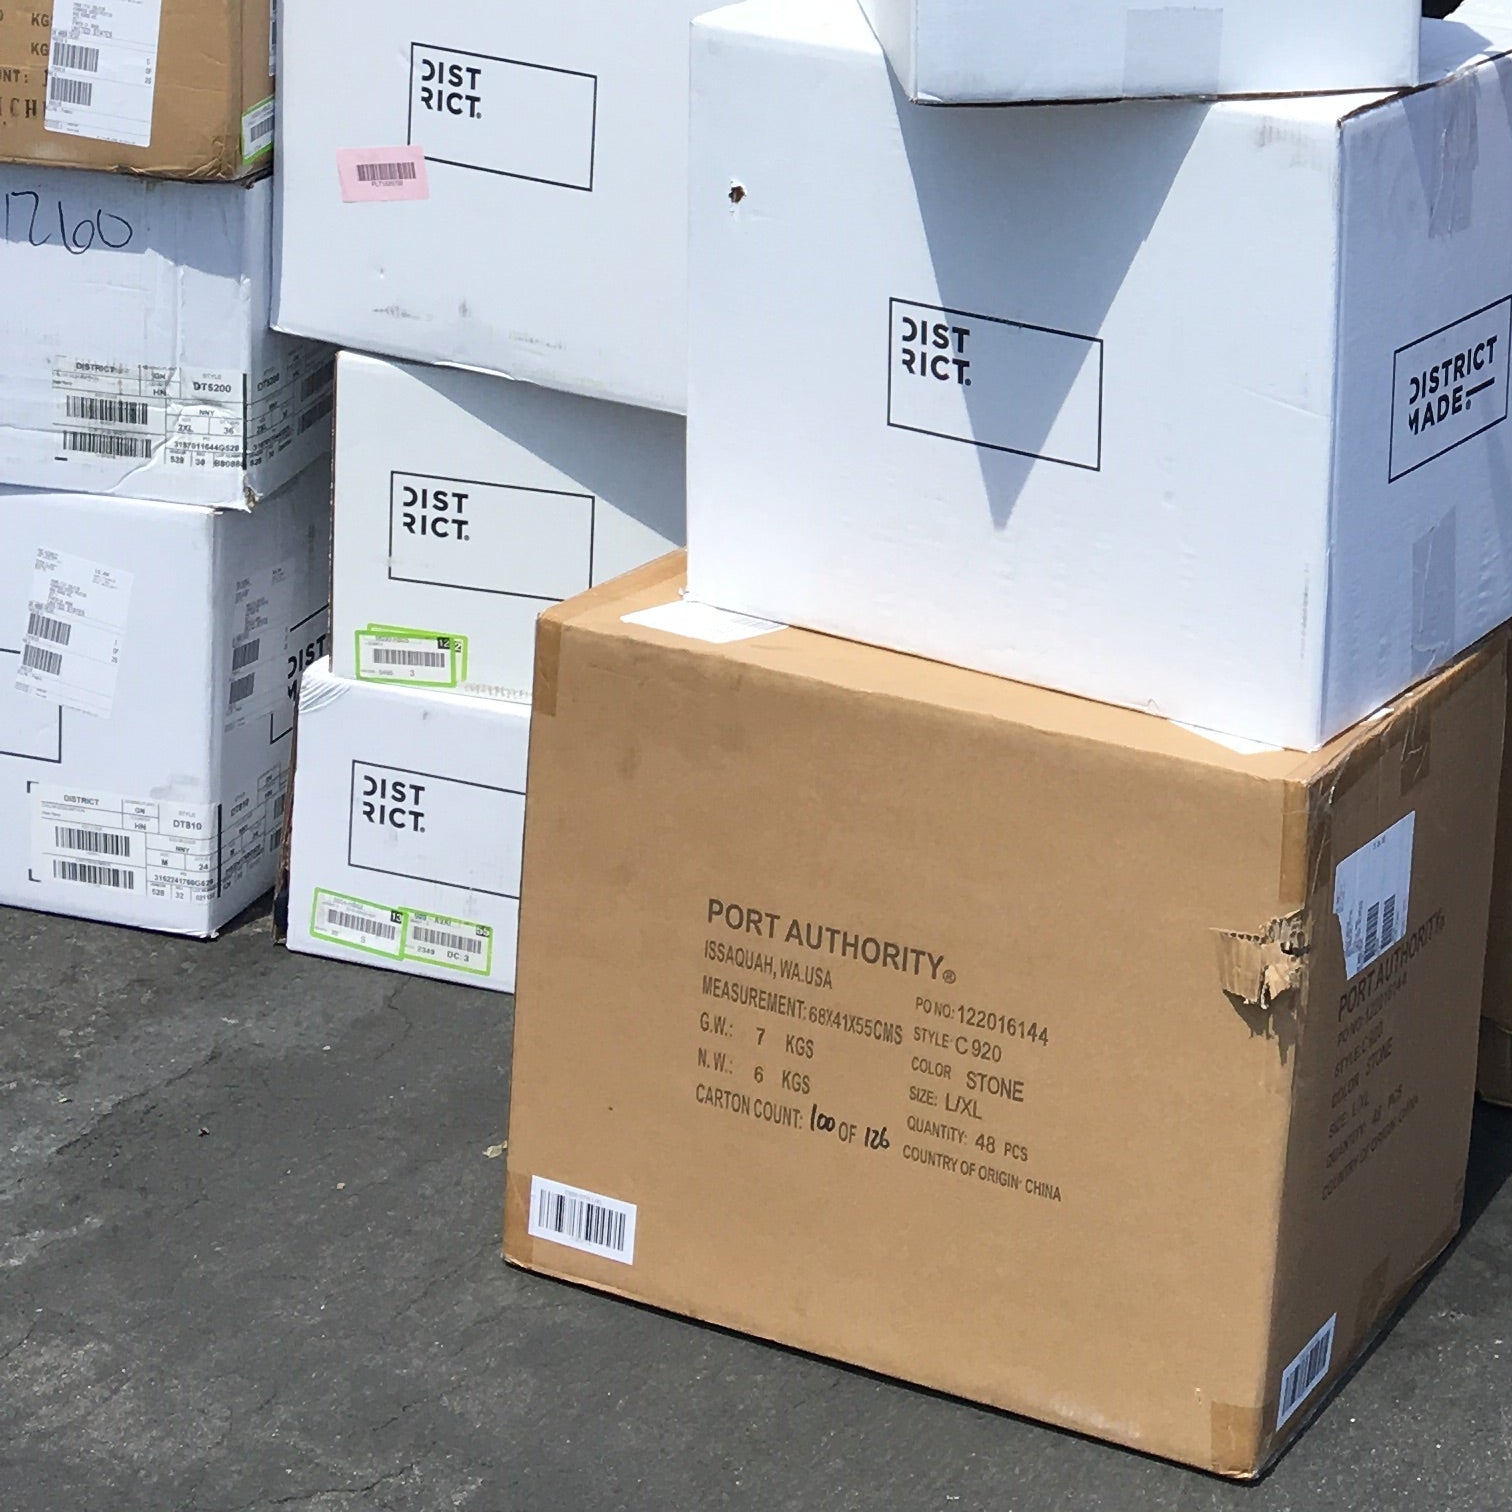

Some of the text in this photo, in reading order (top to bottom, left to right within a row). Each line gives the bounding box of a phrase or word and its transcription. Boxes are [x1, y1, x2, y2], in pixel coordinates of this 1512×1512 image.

[421, 58, 482, 90] DIST
[902, 316, 970, 353] DIST
[75, 361, 116, 374] DISTRICT
[1409, 335, 1498, 405] DISTRICT
[192, 381, 232, 393] DT5200
[403, 485, 469, 514] DIST
[63, 794, 100, 806] DISTRICT
[363, 774, 426, 806] DIST
[172, 819, 203, 831] DT810
[708, 897, 782, 939] PORT
[446, 950, 460, 961] DC
[703, 939, 777, 980] ISSAQUAH,
[1338, 969, 1376, 1023] PORT
[915, 996, 1050, 1046] PO NO: 122016144
[755, 1027, 766, 1046] 7
[785, 1033, 815, 1060] KGS
[954, 1036, 969, 1055] C
[971, 1039, 1003, 1063] 920
[754, 1065, 764, 1084] 6
[781, 1069, 811, 1095] KGS
[911, 1055, 1025, 1103] COLOR STONE
[695, 1083, 750, 1116] CARTON
[753, 1098, 804, 1130] COUNT:
[838, 1121, 858, 1144] OF
[945, 1092, 983, 1120] L/XL
[906, 1115, 1029, 1162] QUANTITY: 48 PCS
[902, 1144, 958, 1173] COUNTRY
[959, 1160, 976, 1176] OF
[1025, 1178, 1062, 1203] CHINA
